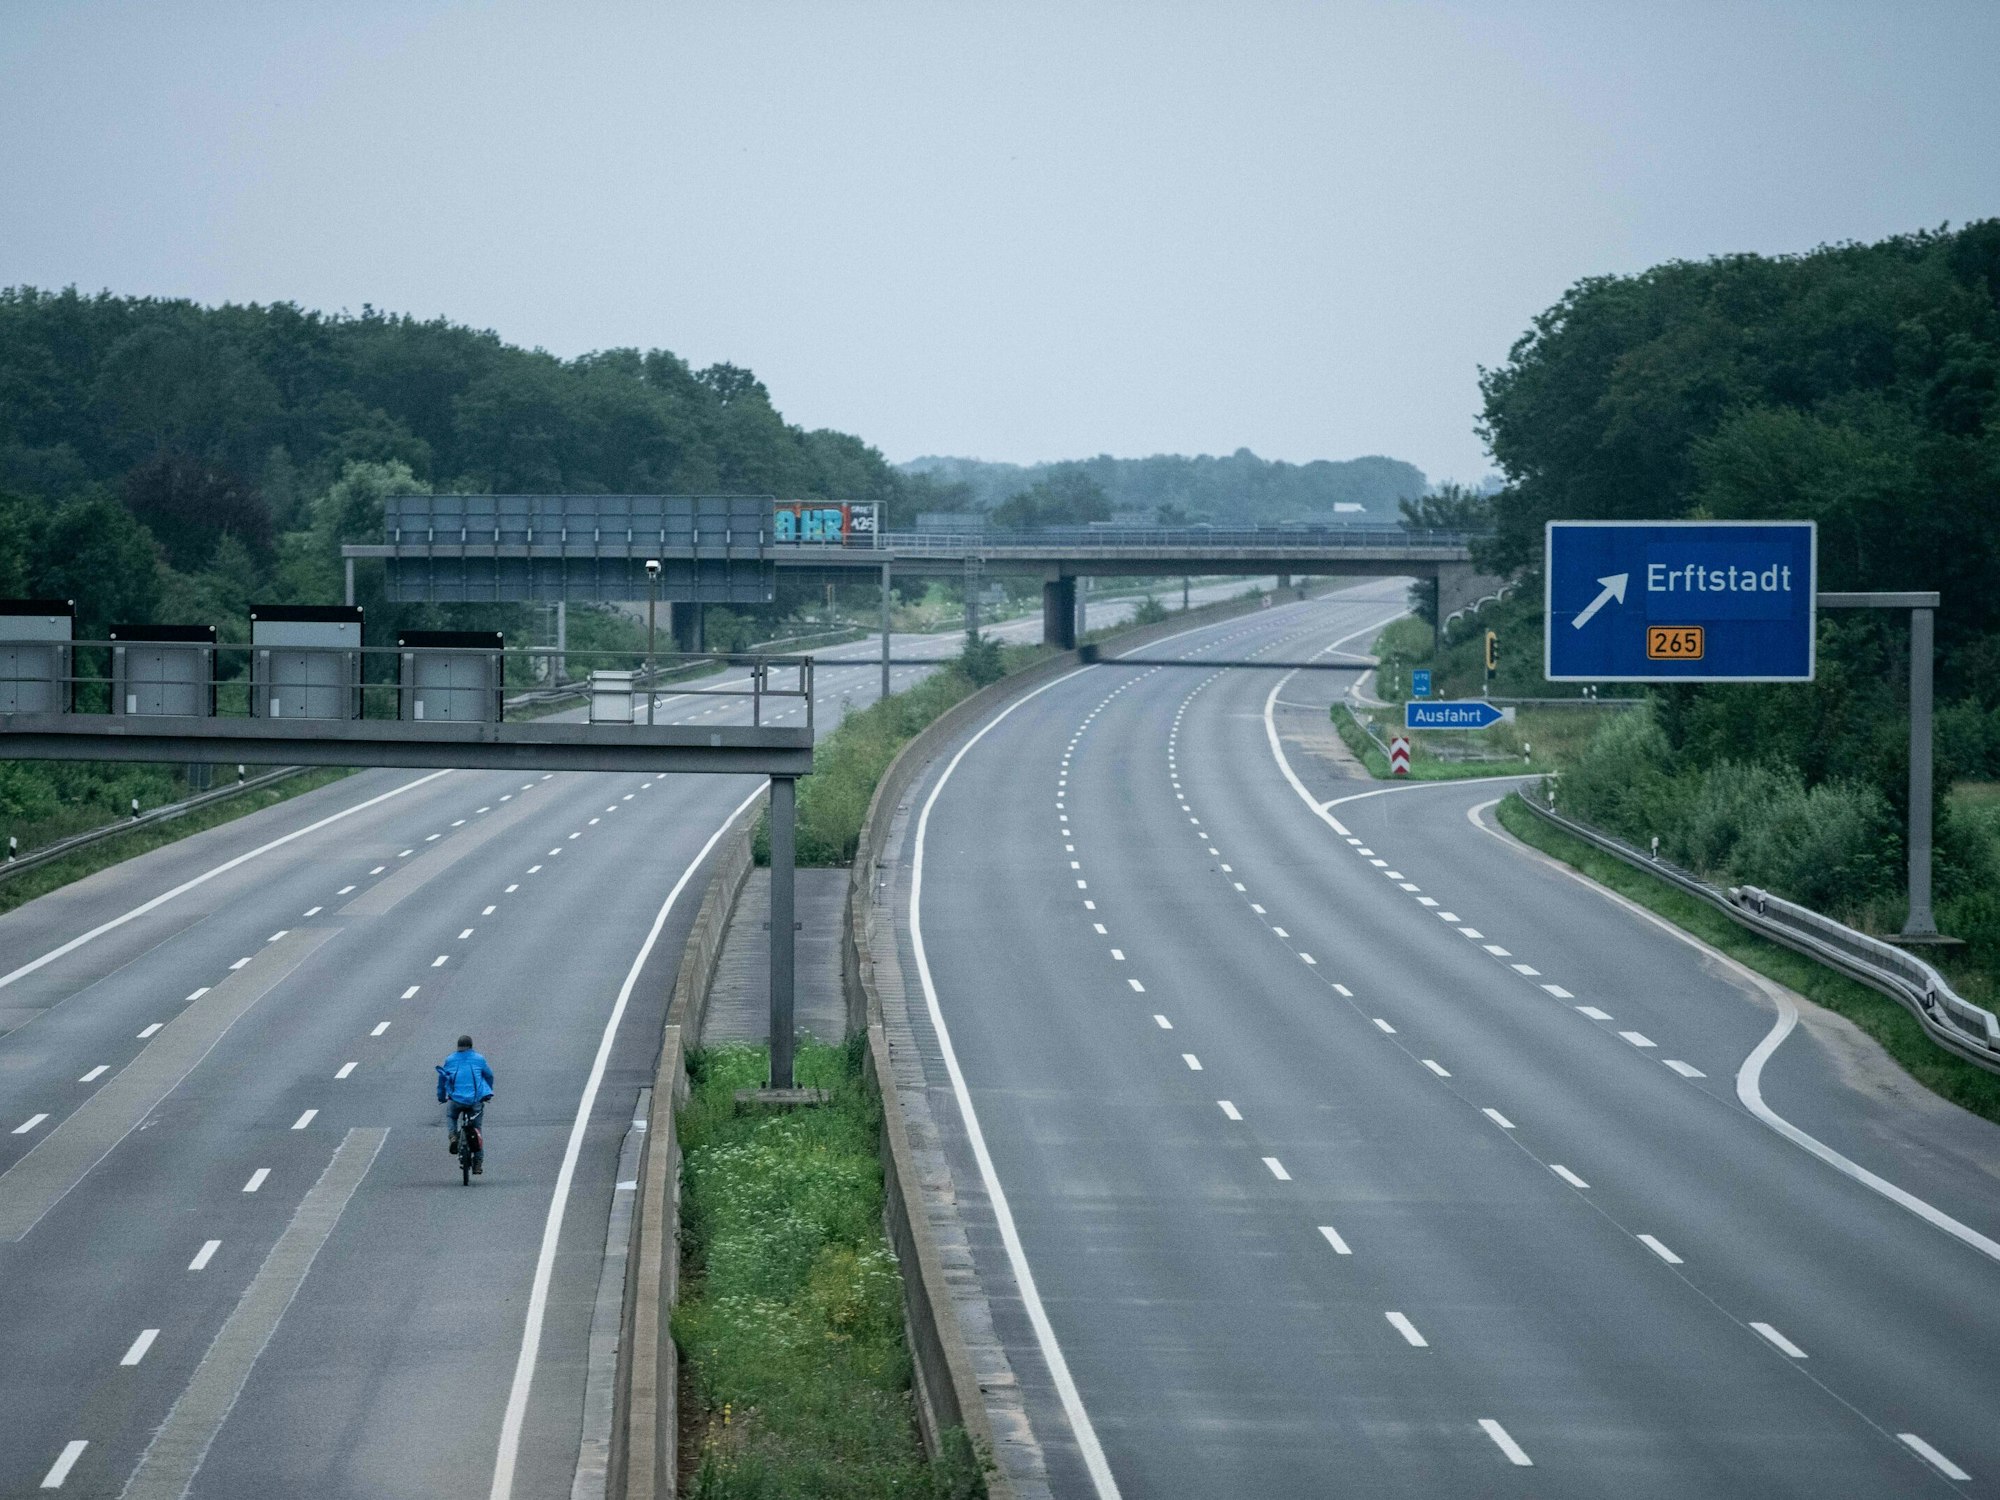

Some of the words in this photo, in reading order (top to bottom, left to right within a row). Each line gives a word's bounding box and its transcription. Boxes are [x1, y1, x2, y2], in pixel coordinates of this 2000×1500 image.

[1647, 563, 1792, 592] Erftstadt
[1654, 633, 1697, 653] 265
[1415, 709, 1481, 722] Ausfahrt
